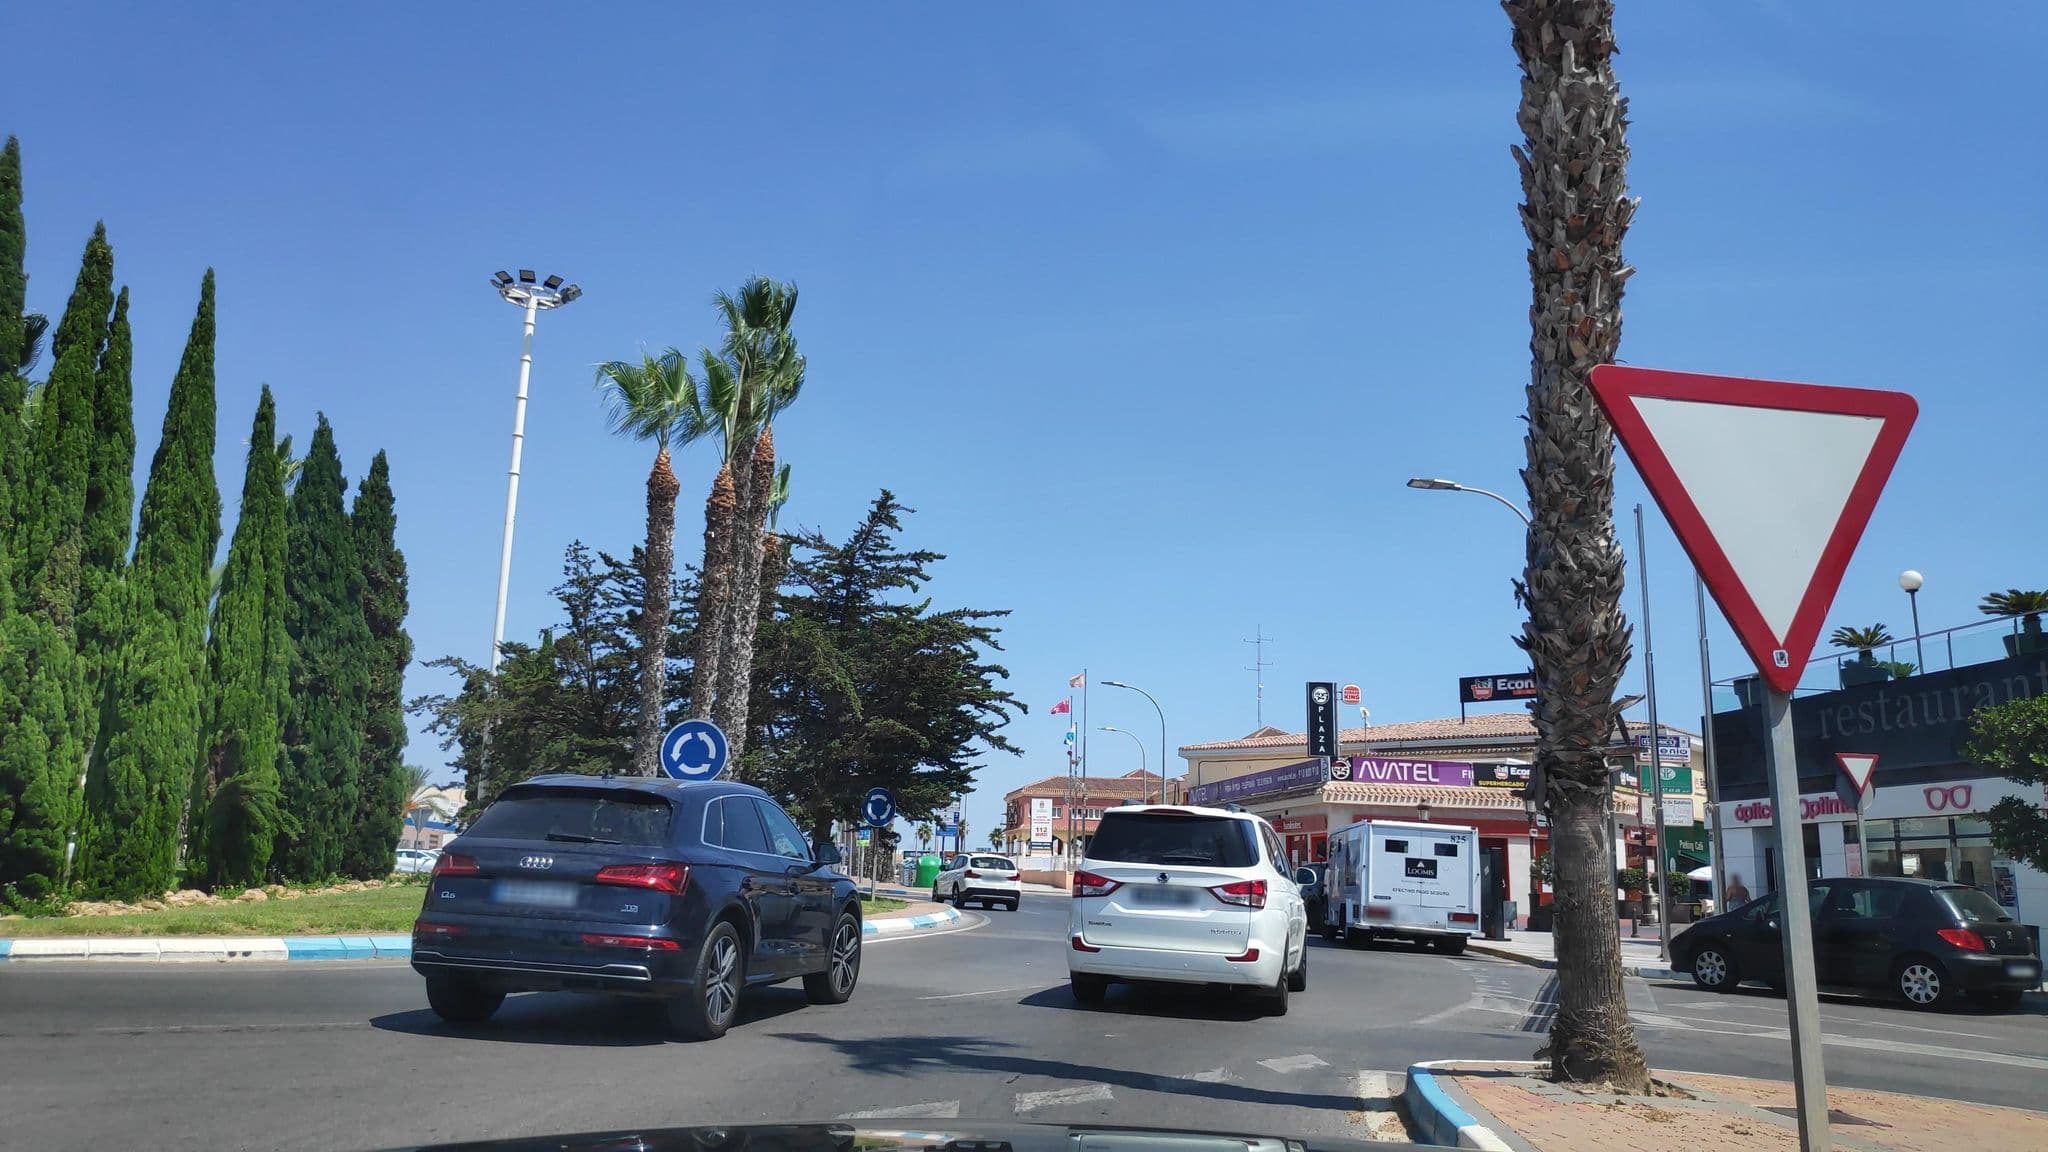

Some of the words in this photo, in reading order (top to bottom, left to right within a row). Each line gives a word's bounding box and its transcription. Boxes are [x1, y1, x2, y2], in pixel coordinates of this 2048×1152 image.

[1817, 659, 2048, 740] restaurant
[1318, 705, 1326, 753] PLAZA
[1359, 760, 1440, 783] AVATEL
[1450, 834, 1467, 844] 825
[1407, 867, 1434, 876] LOOMIS
